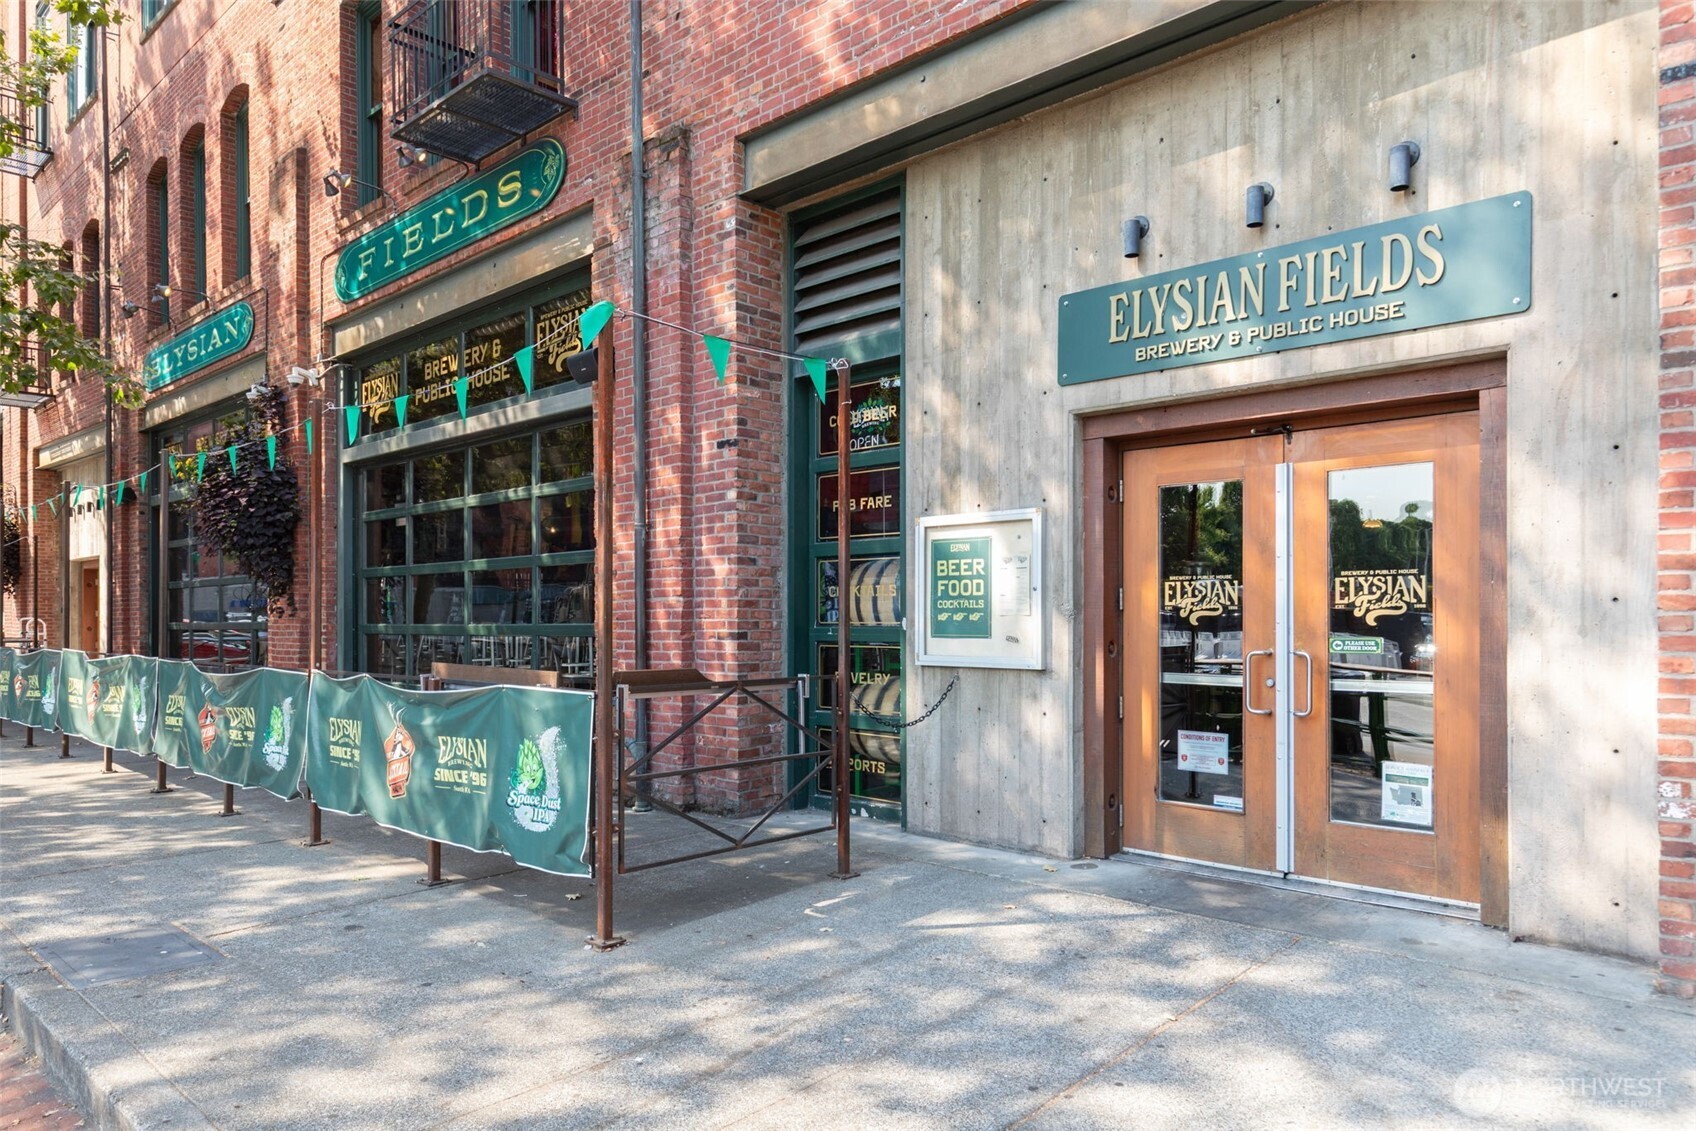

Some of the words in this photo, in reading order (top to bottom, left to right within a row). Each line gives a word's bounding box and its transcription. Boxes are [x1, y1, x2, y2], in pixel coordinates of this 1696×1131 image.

[358, 170, 522, 281] FIELDS
[1108, 262, 1266, 344] ELYSIAN
[1278, 224, 1445, 313] FIELDS
[536, 308, 586, 353] ELYSIA
[1135, 333, 1222, 362] BREWERY
[1229, 330, 1241, 346] &
[1247, 315, 1323, 343] PUBLIC
[1329, 301, 1406, 328] HOUSE
[150, 316, 240, 379] ELYSIAN
[425, 347, 488, 381] BREWERY
[492, 338, 502, 357] &
[415, 376, 458, 405] PUBLIC
[467, 366, 511, 391] HOUSE
[850, 434, 880, 451] OPEN
[833, 498, 856, 513] PB
[860, 495, 892, 510] FARE
[937, 558, 985, 576] BEER
[828, 584, 897, 598] CKTAILS
[937, 579, 985, 597] FOOD
[1164, 580, 1239, 606] ELYSIAN
[1334, 575, 1427, 604] ELYSIAN
[937, 600, 985, 609] COCKTAILS
[1179, 597, 1223, 626] Fields
[1353, 594, 1408, 627] Fields
[835, 671, 891, 685] VELRY
[1181, 733, 1205, 741] CONDITIONS
[330, 745, 351, 759] SINCE
[438, 735, 487, 768] ELYSIAN
[434, 768, 469, 784] SINCE
[470, 770, 487, 787] '96
[507, 790, 540, 808] Space
[541, 795, 561, 811] Dust
[532, 808, 550, 824] IPA
